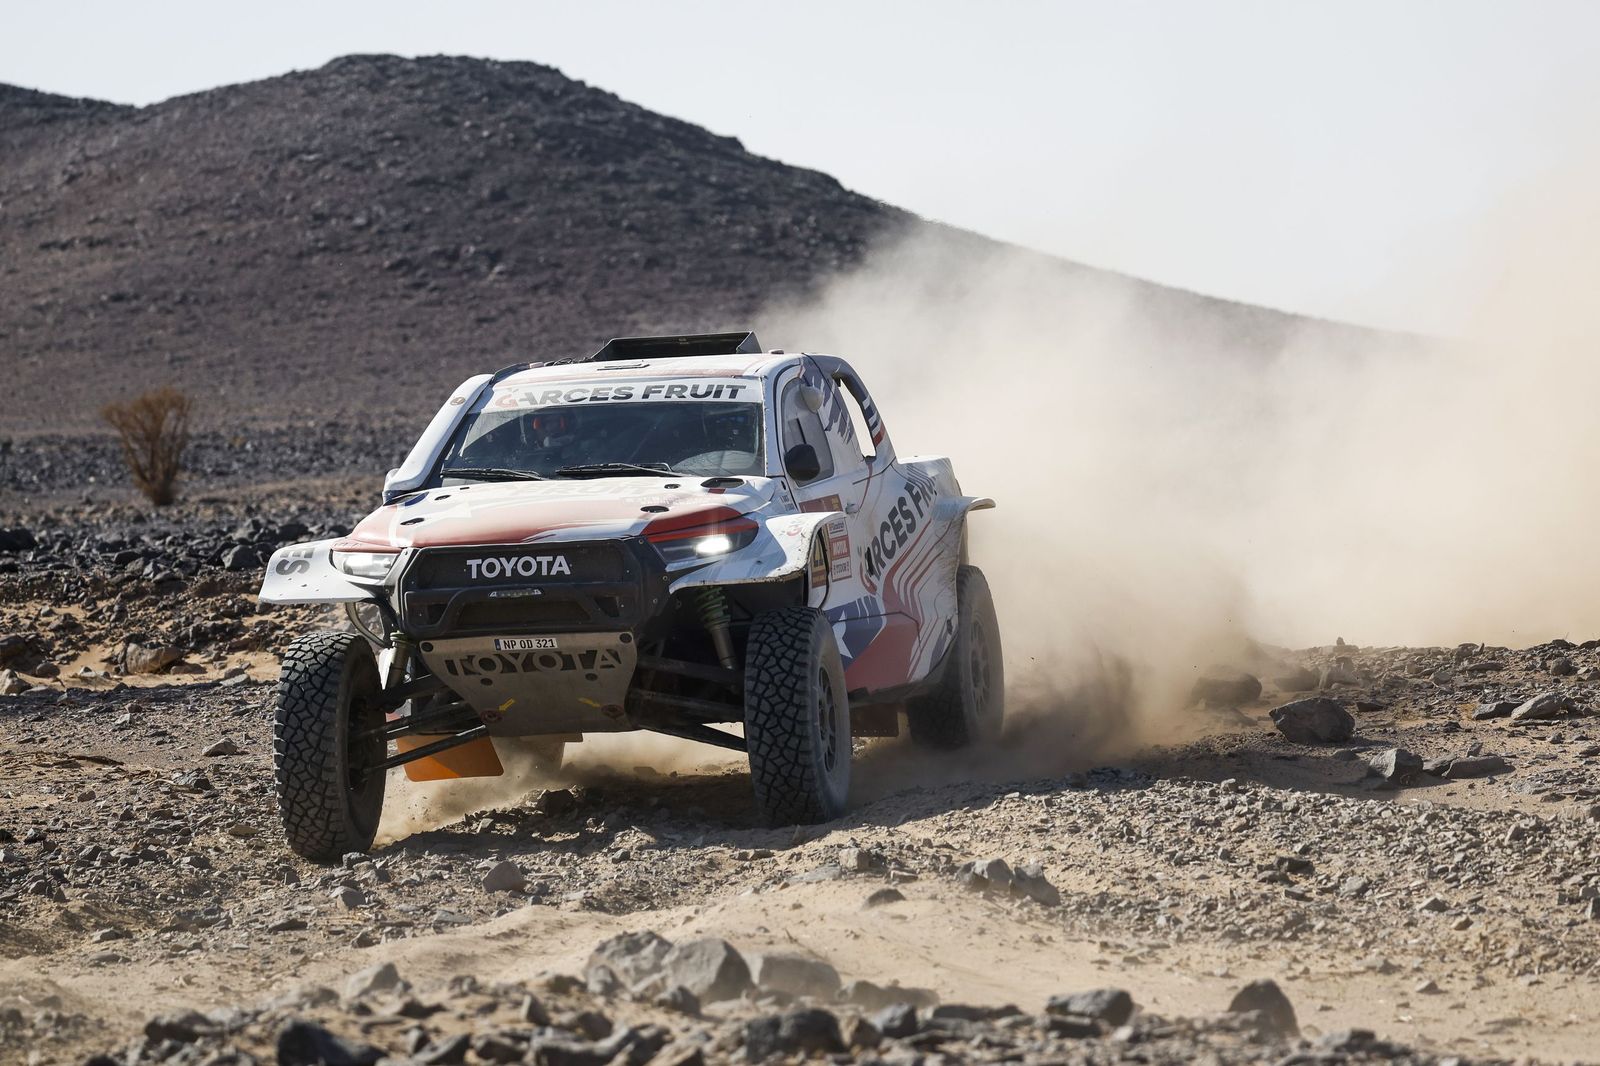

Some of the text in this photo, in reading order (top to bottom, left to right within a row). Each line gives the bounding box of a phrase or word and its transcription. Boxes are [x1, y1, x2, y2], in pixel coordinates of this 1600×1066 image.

[641, 384, 747, 400] FRUIT
[466, 555, 571, 579] TOYOTA
[503, 639, 517, 650] NP
[535, 638, 555, 648] 321
[445, 649, 622, 677] TOYOTA
